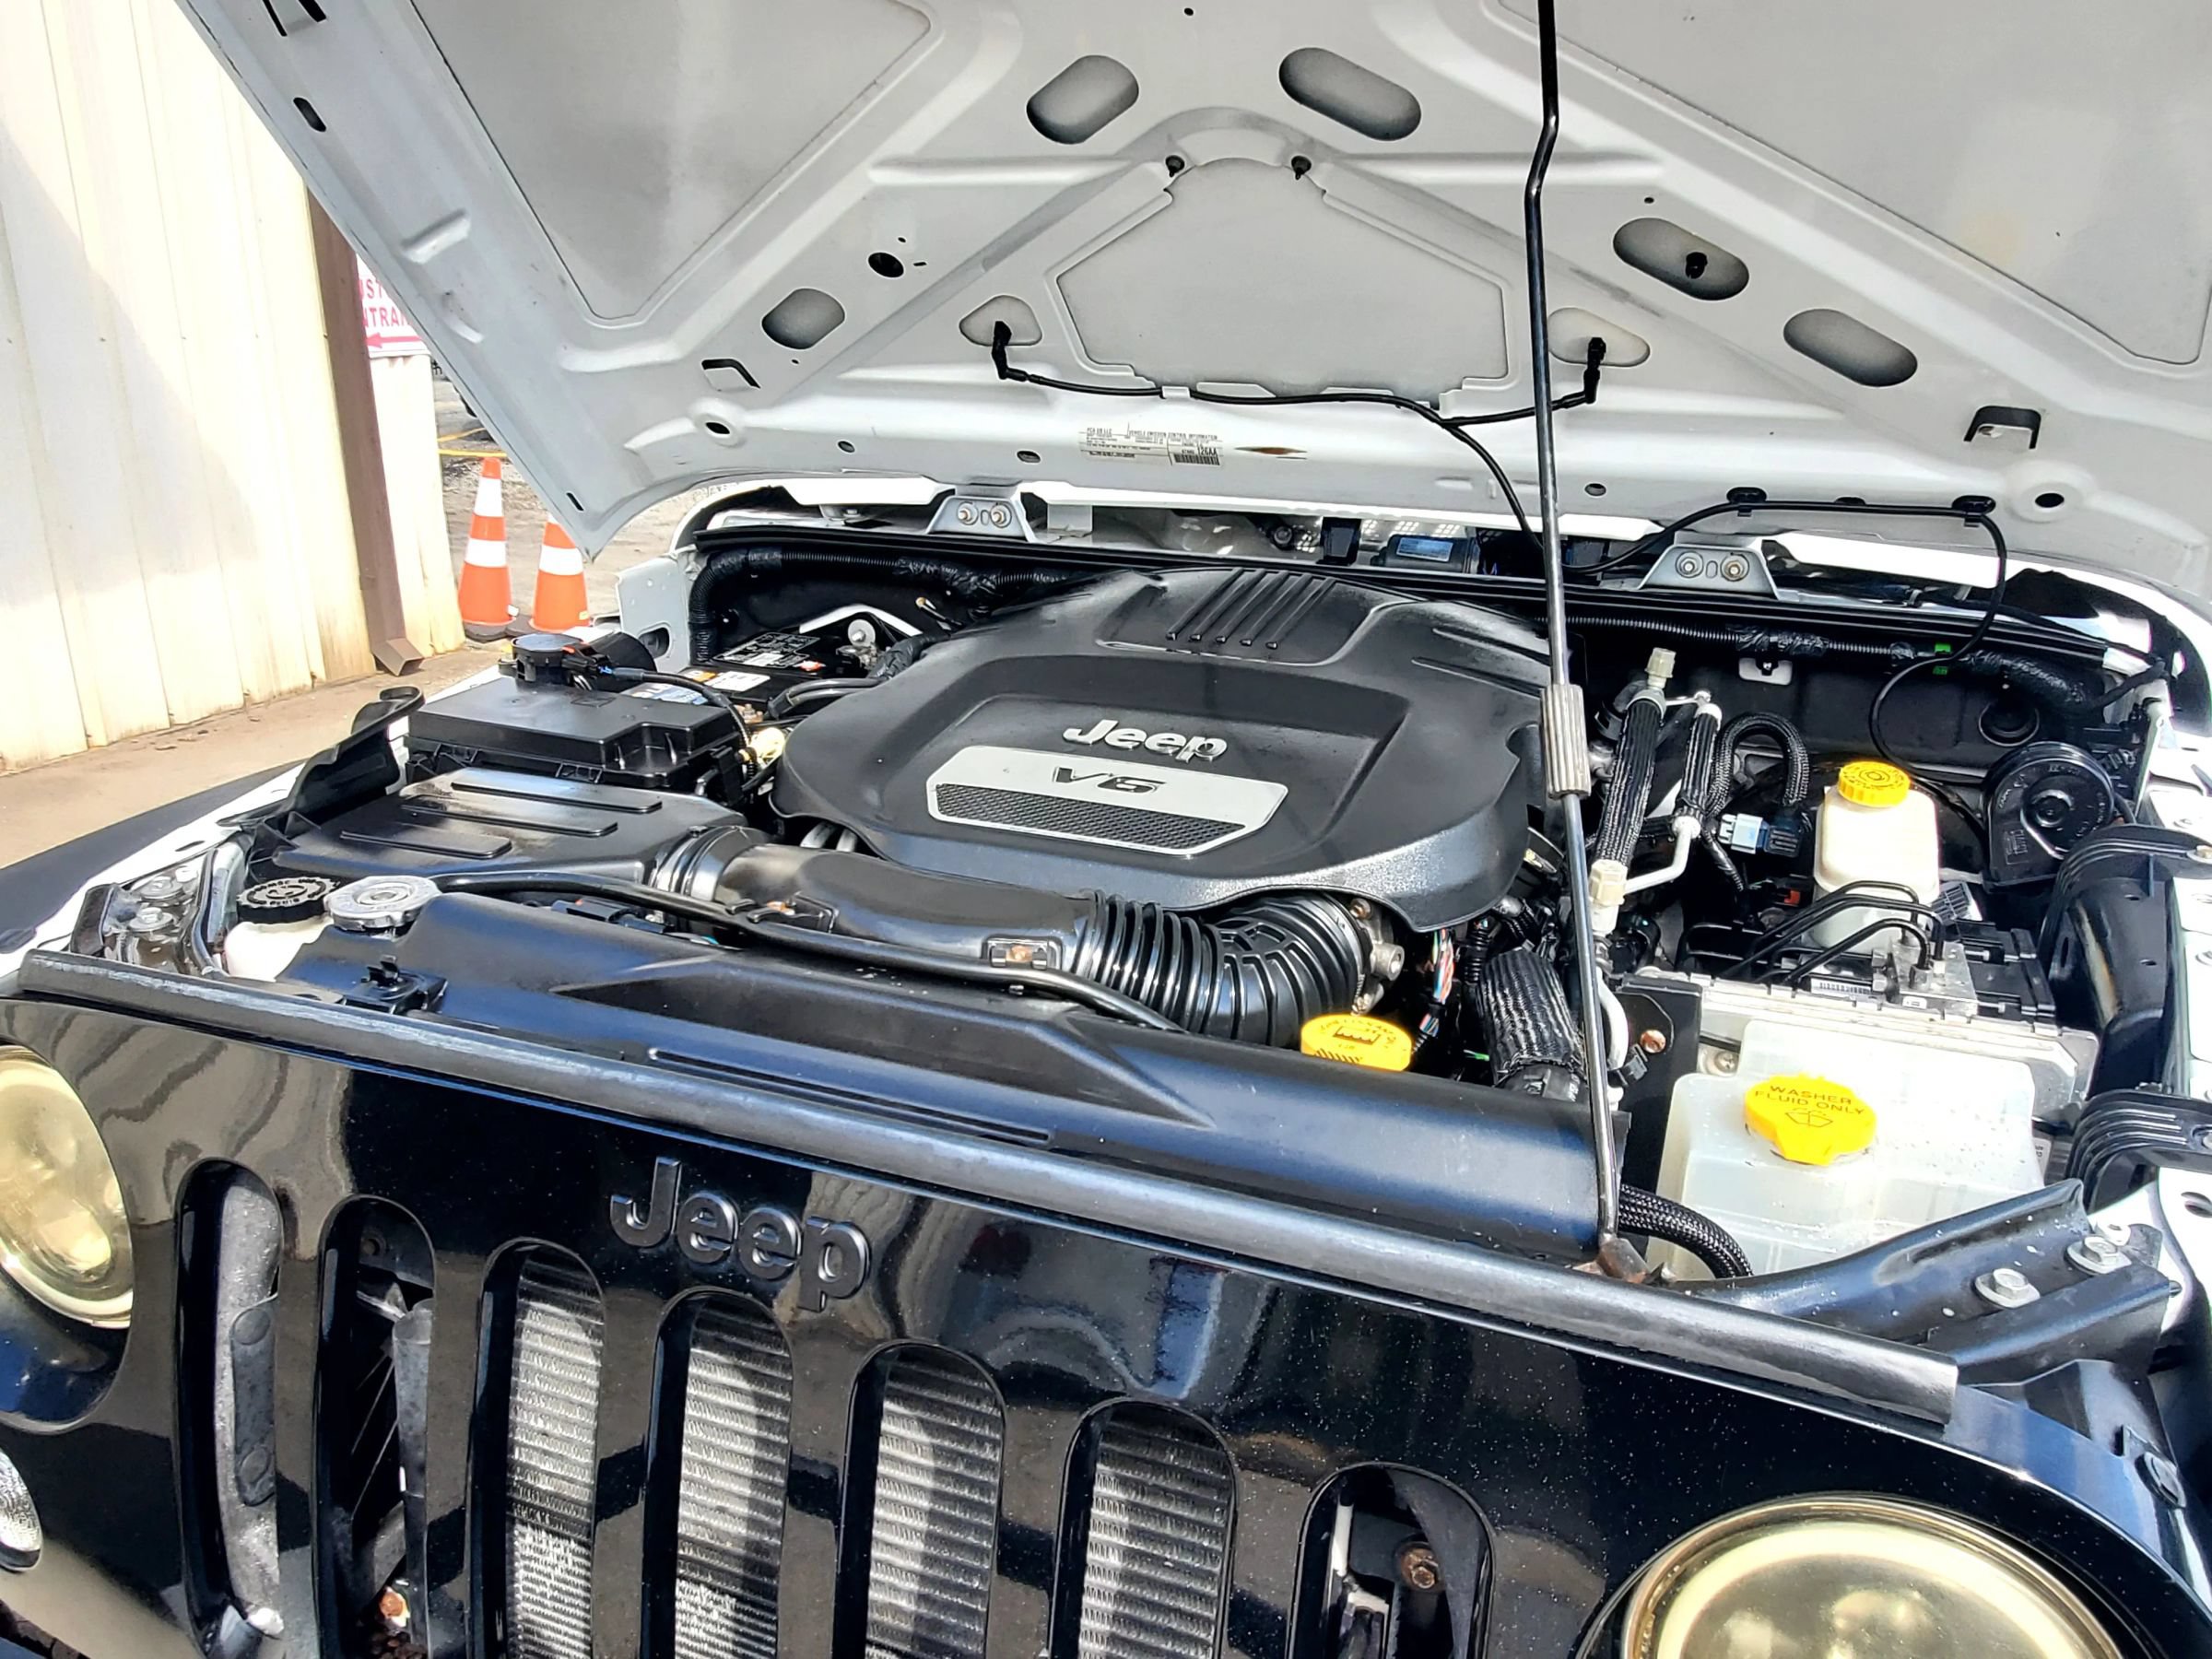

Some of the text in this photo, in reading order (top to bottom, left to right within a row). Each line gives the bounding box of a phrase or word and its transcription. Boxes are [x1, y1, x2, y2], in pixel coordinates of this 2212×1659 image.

[1062, 718, 1229, 763] Jeep
[1052, 765, 1167, 795] V6
[1754, 1089, 1866, 1116] FLUID ONLY
[1770, 1084, 1853, 1106] WASHER
[609, 1156, 872, 1313] Jeep
